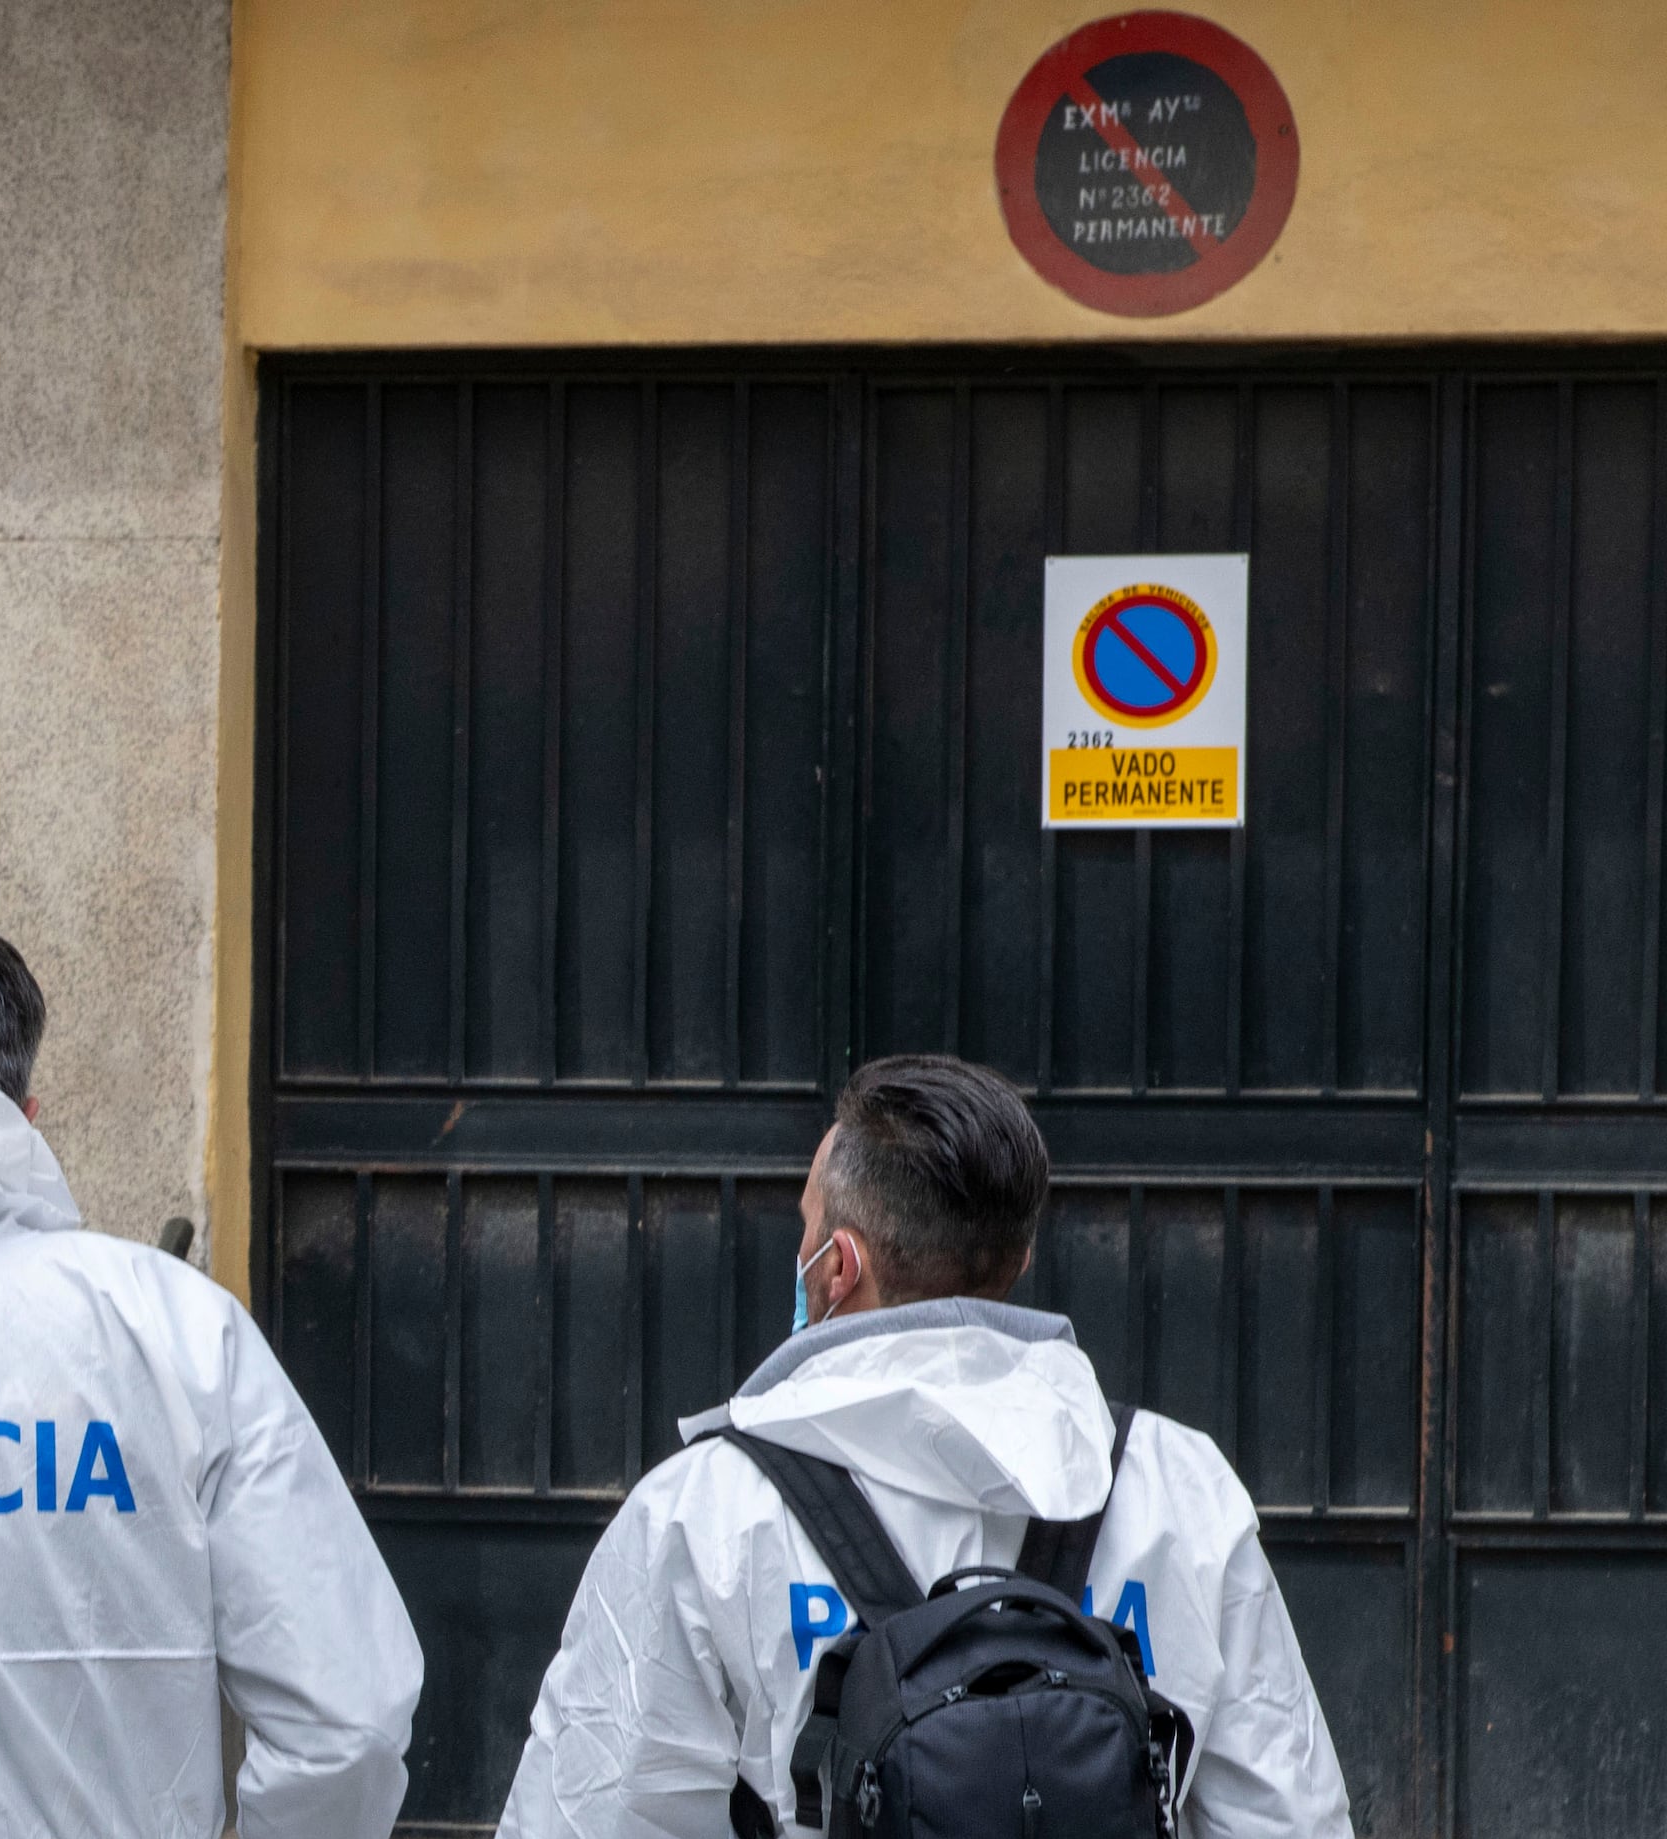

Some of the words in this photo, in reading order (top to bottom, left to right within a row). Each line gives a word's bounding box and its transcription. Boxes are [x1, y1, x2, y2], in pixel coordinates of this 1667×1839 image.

[1079, 145, 1187, 174] LICENCIA
[1073, 213, 1225, 243] PERMANENTE
[1068, 731, 1114, 749] 2362
[1112, 752, 1176, 777] VADO
[1064, 779, 1224, 807] PERMANENTE
